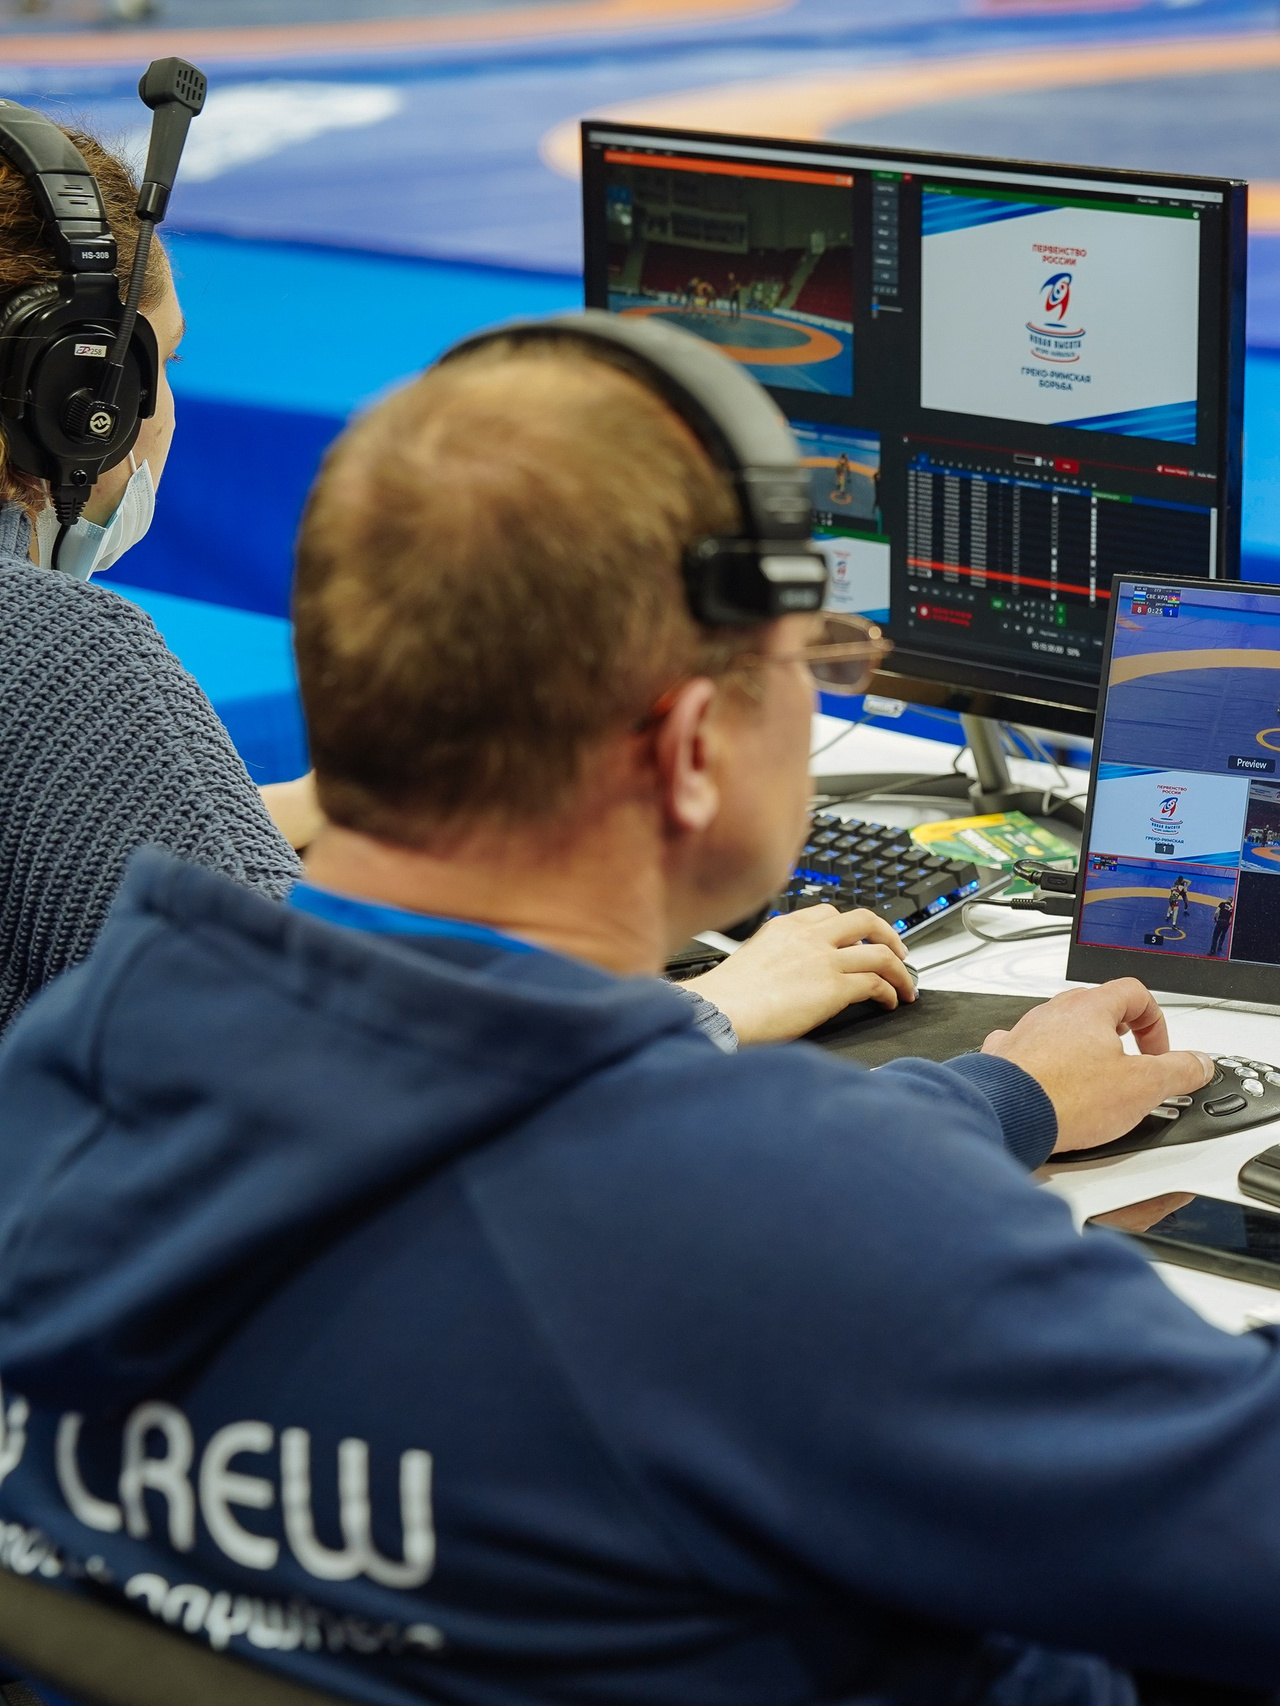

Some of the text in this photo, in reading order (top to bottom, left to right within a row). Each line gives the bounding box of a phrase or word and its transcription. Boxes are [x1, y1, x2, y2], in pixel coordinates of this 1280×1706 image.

[1032, 244, 1087, 257] ПЕРВЕНСТВО
[1042, 256, 1077, 266] РОССИИ
[1021, 367, 1091, 383] ГРЕКО-РИМСКАЯ
[1039, 380, 1073, 391] БОРЬБА
[1237, 758, 1267, 770] Preview
[1157, 784, 1187, 792] ПЕРВЕНСТВО
[1145, 836, 1184, 844] ГРЕКО-РИМСКАЯ
[1151, 936, 1157, 944] 5
